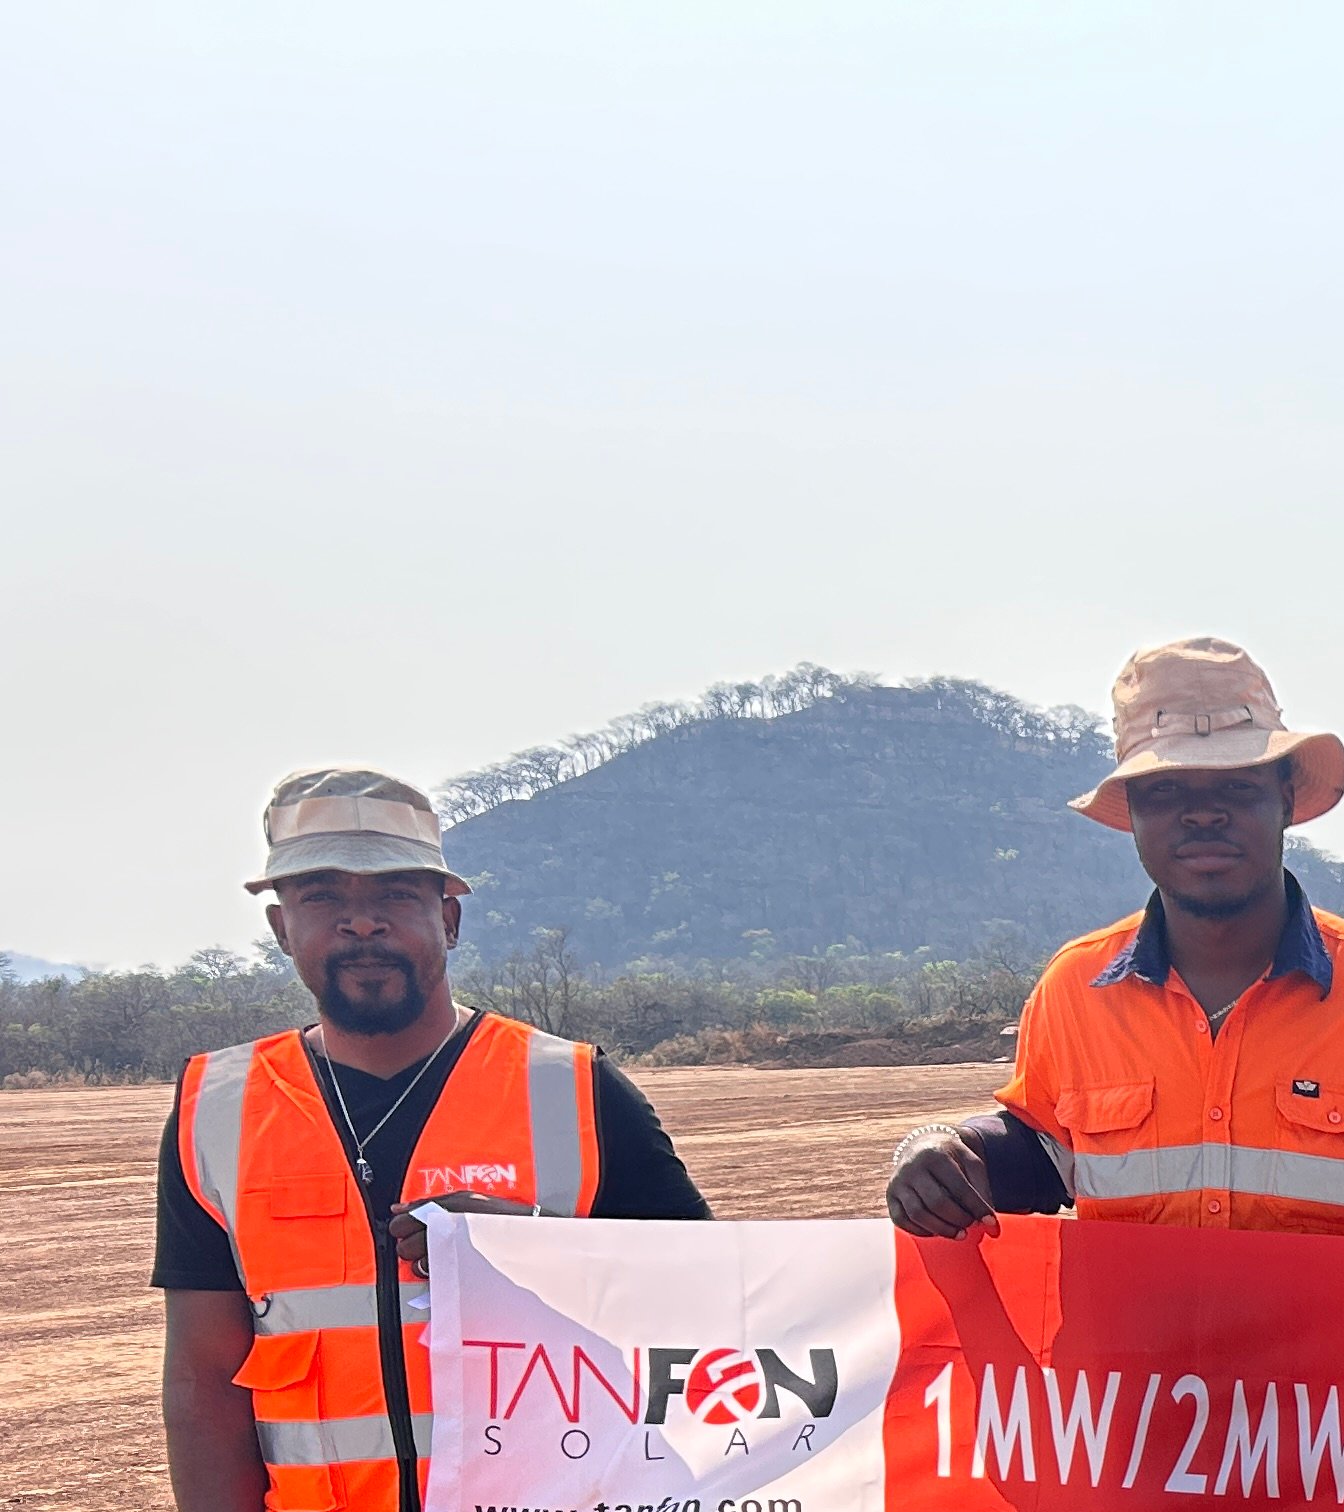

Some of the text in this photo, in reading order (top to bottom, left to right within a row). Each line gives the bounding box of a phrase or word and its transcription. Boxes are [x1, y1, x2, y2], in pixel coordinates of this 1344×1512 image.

[417, 1164, 517, 1187] TANFON
[462, 1339, 838, 1425] TANFON
[484, 1424, 816, 1461] SOLAR
